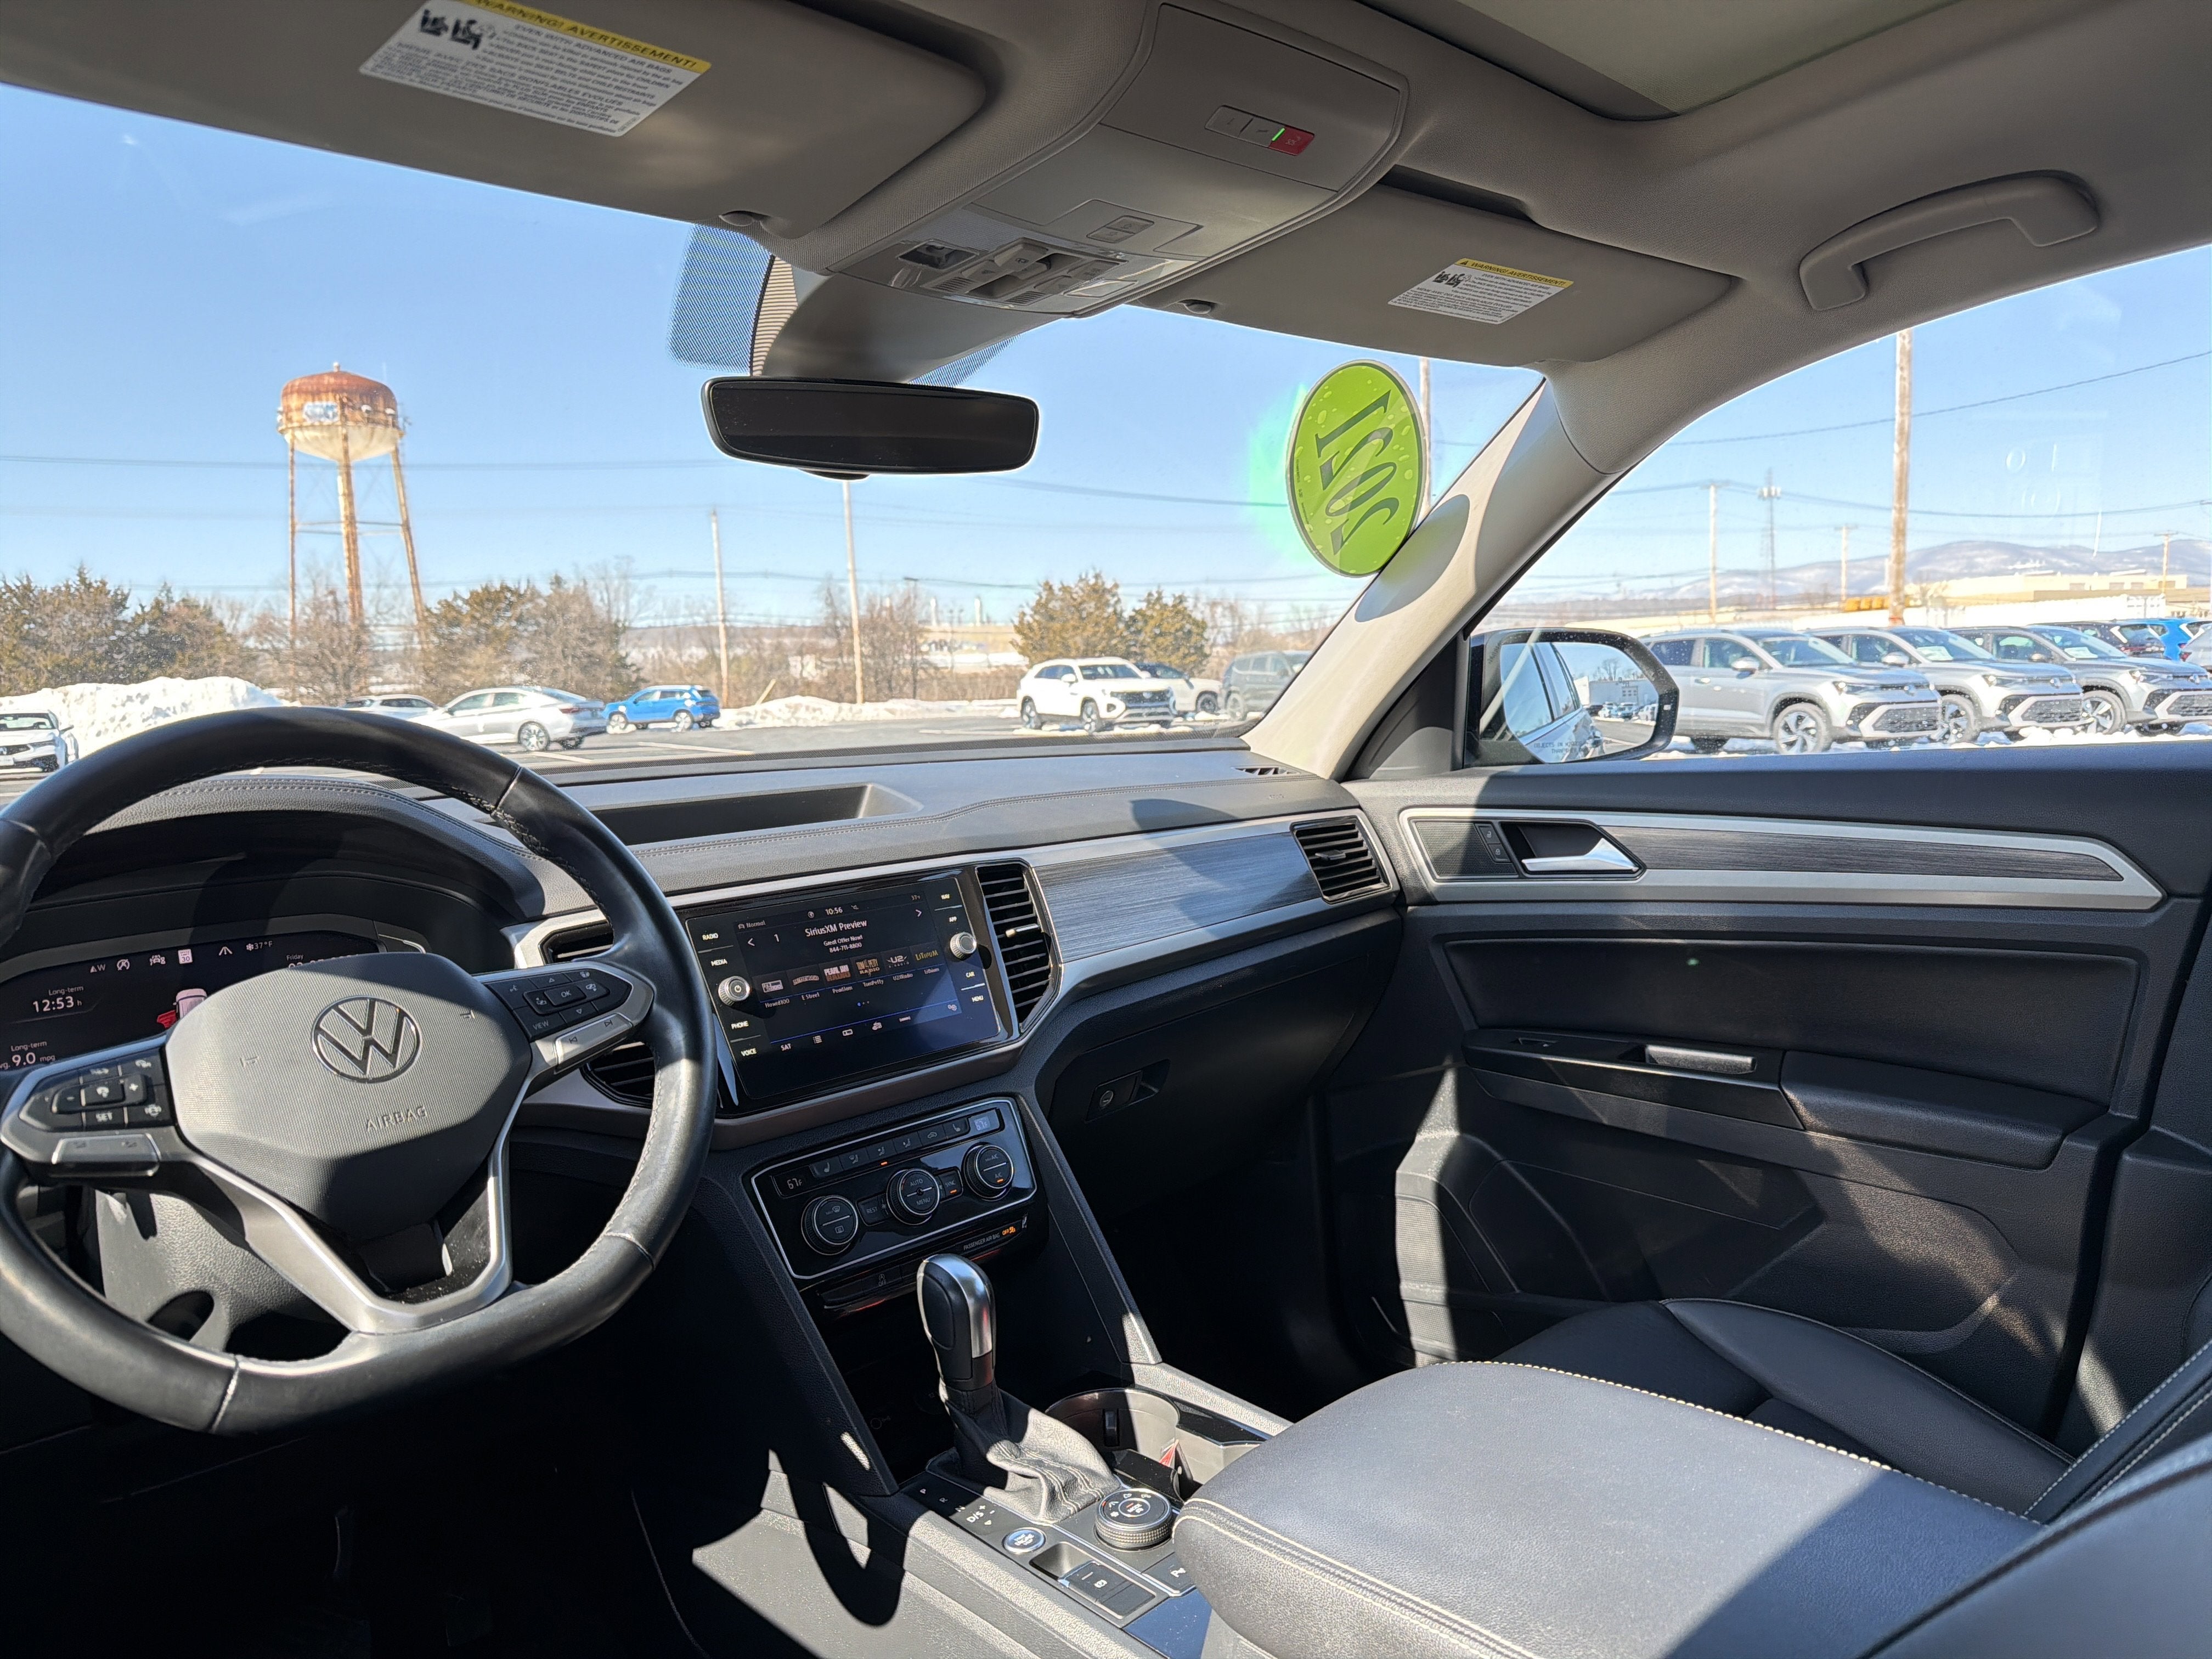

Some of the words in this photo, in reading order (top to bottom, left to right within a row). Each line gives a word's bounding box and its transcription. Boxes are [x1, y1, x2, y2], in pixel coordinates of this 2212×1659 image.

[568, 26, 697, 68] AVERTISSEMENT!
[572, 42, 631, 61] ADVANCED
[628, 58, 648, 66] AIR
[645, 63, 674, 74] BAGS
[1470, 262, 1508, 273] WARNING!
[1507, 270, 1566, 286] AVERTISSEMENT!
[825, 906, 843, 916] 10:56
[746, 920, 766, 928] Normal
[805, 924, 837, 937] SiriusXM
[839, 919, 868, 930] Preview
[774, 934, 780, 943] 1
[254, 940, 273, 950] 37°F
[711, 958, 728, 967] MEDIA
[890, 955, 905, 963] U2
[48, 986, 84, 996] Long-term
[32, 996, 74, 1013] 12:53
[533, 1020, 549, 1031] VIEW
[731, 1020, 749, 1029] PHONE
[10, 1041, 47, 1052] Long-term
[741, 1048, 757, 1057] VOICE
[12, 1052, 36, 1066] 9.0
[95, 1112, 113, 1122] SET
[367, 1105, 427, 1132] AIRBAG
[917, 1197, 930, 1205] MENU
[963, 1238, 986, 1250] PASSENGER
[966, 1511, 984, 1523] D/S
